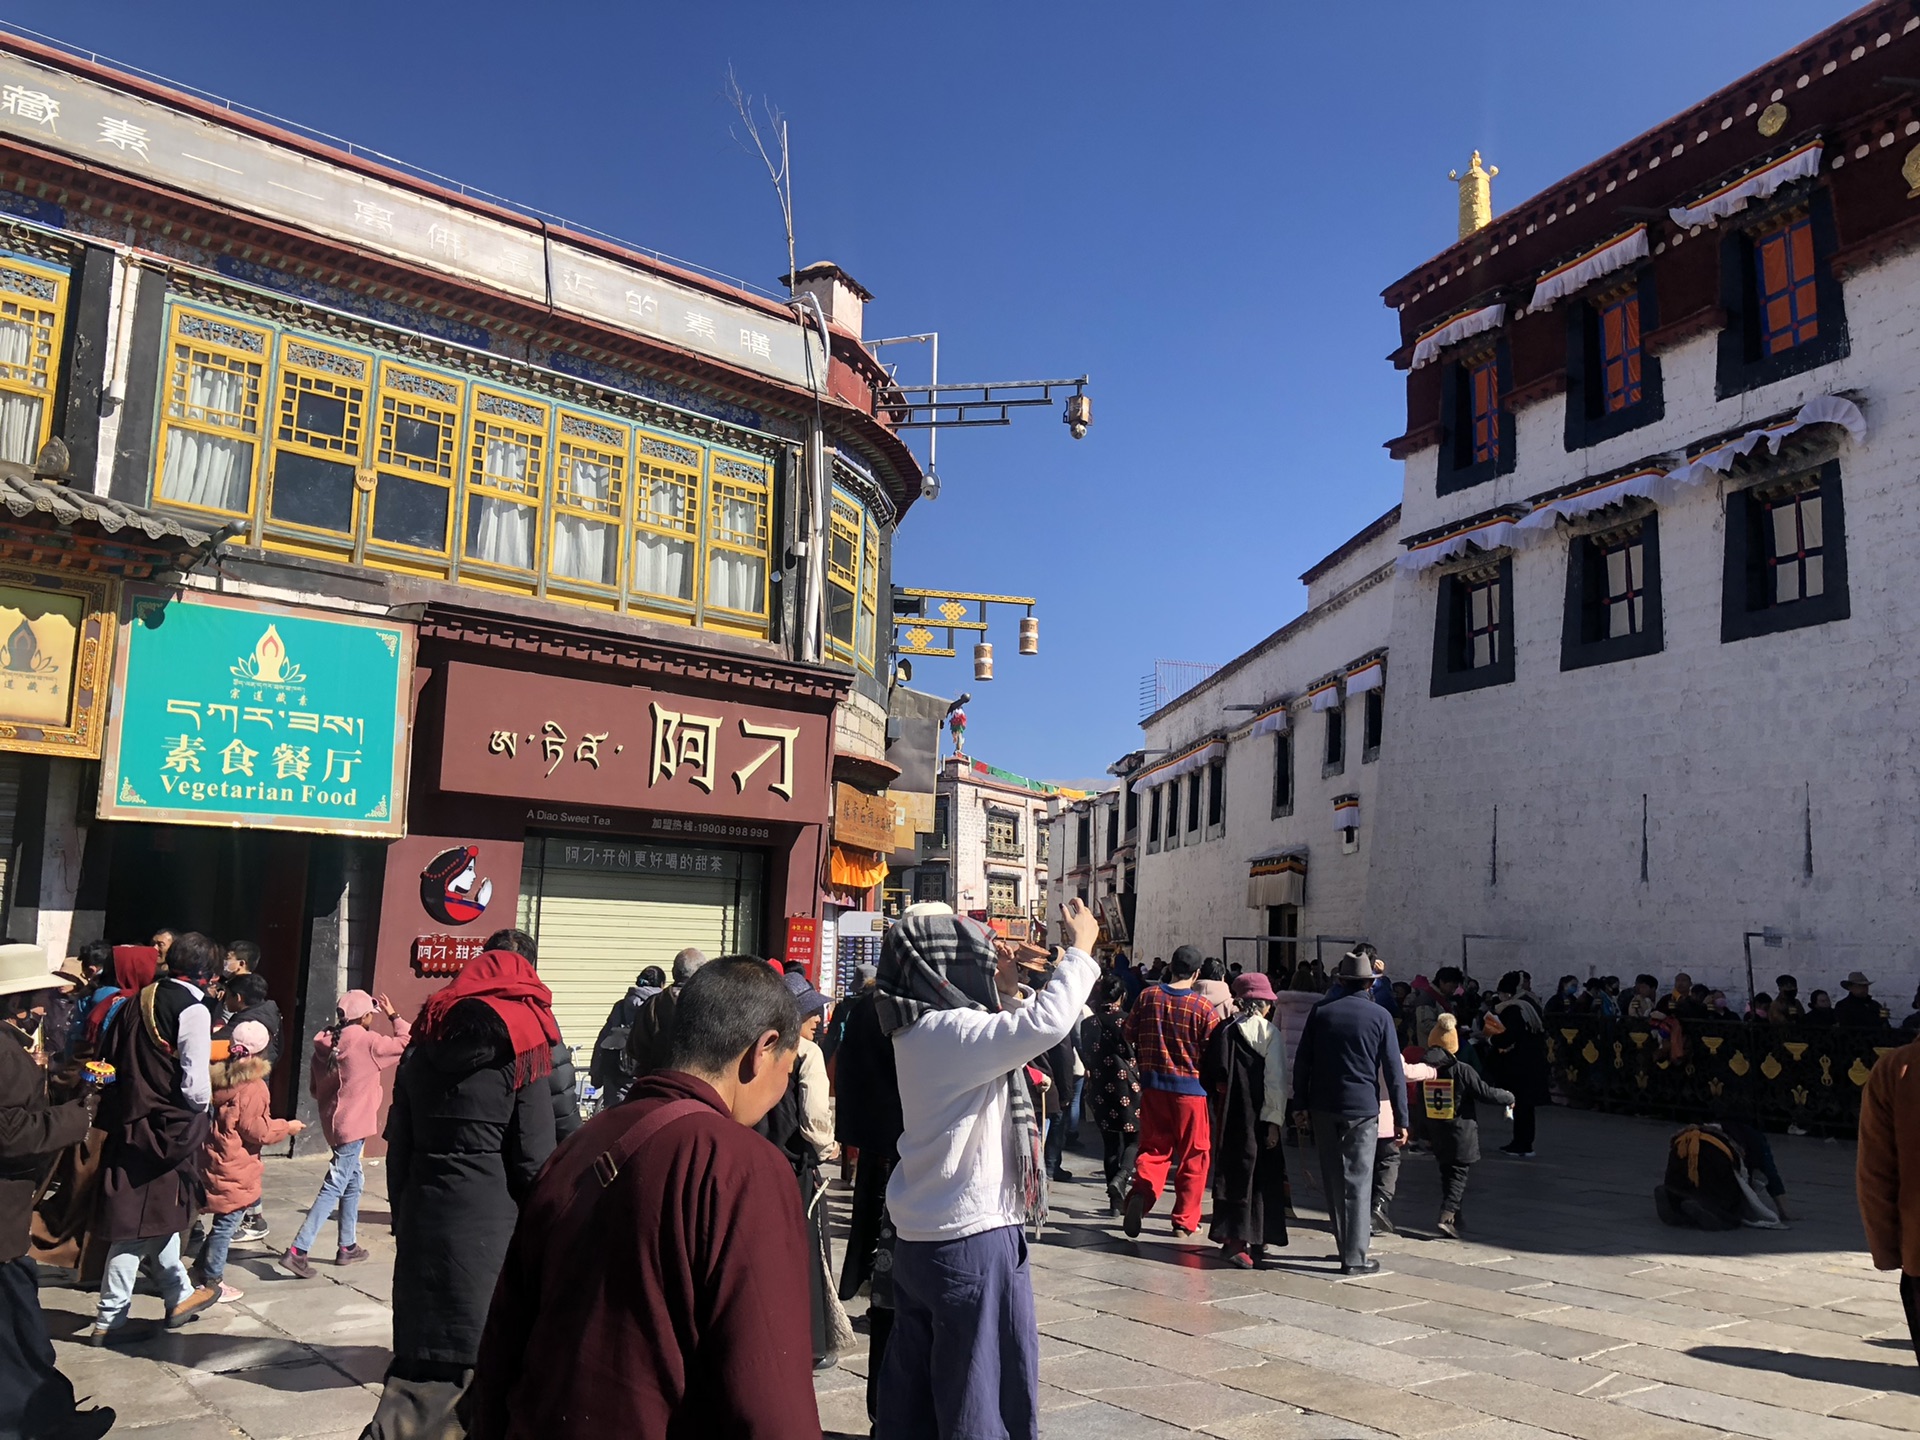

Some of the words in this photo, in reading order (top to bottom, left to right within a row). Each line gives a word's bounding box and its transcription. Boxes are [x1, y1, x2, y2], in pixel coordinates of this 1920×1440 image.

[160, 733, 363, 783] 素食餐厅
[650, 701, 801, 801] 阿刁
[160, 774, 294, 802] Vegetarian
[302, 785, 358, 806] Food
[527, 809, 535, 819] A
[537, 810, 559, 821] Diao
[560, 812, 590, 824] Sweet
[593, 814, 611, 826] Tea
[729, 825, 748, 837] 998
[750, 828, 769, 838] 998
[1433, 1088, 1443, 1111] 6
